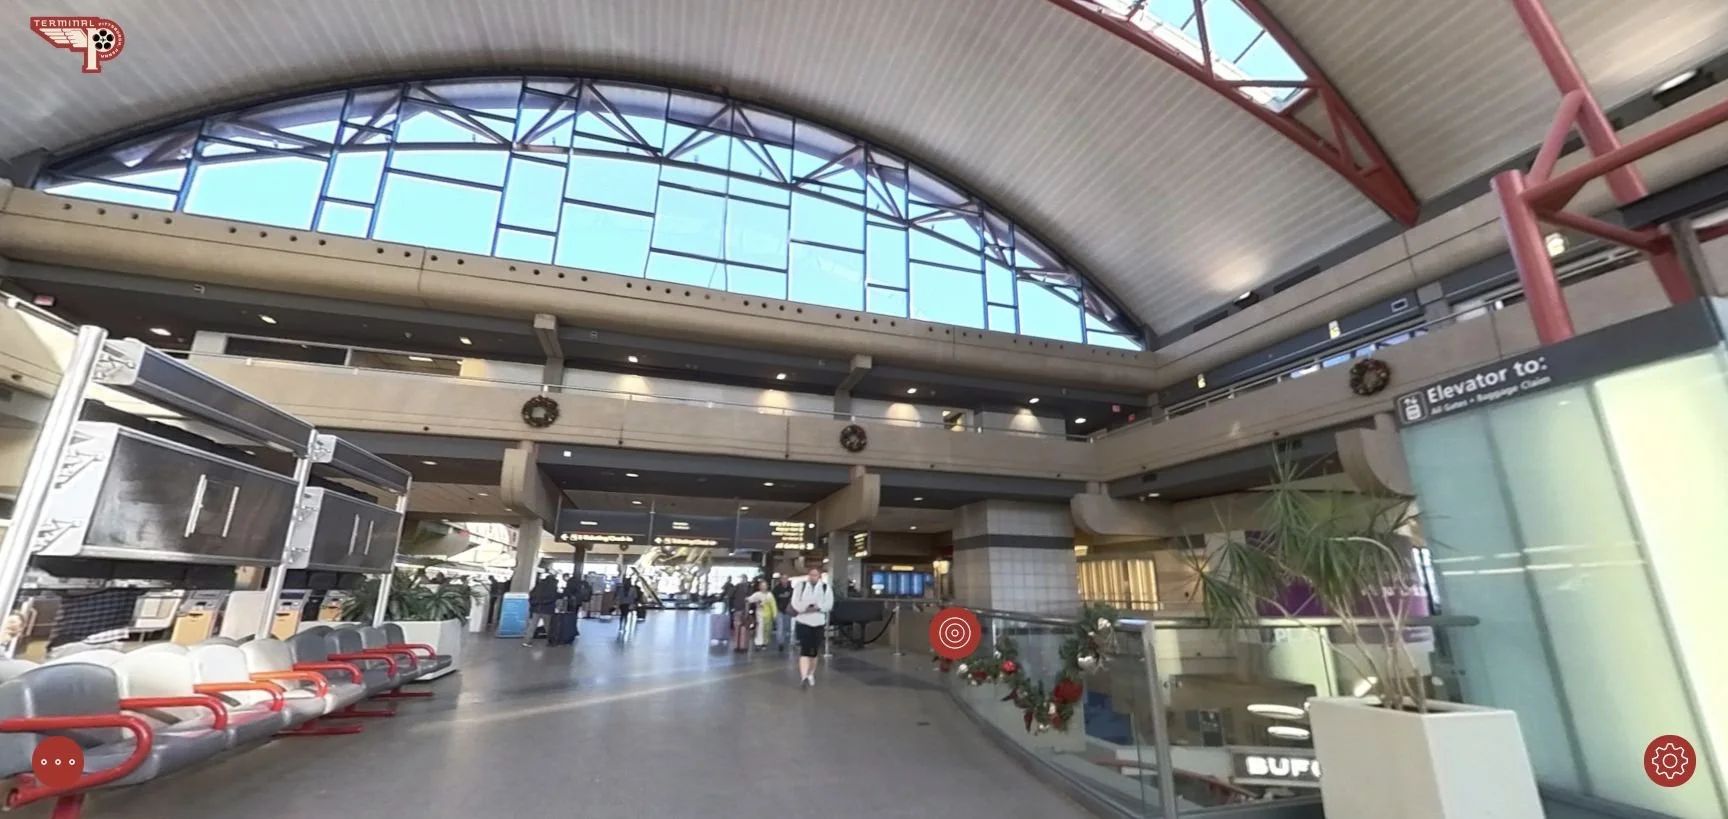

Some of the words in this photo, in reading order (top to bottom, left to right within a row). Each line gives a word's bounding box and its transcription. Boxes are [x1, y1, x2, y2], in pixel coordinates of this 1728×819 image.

[1427, 368, 1508, 403] Elevator
[1513, 356, 1548, 377] to:
[1476, 385, 1519, 403] Baggage
[1520, 376, 1552, 390] Claim
